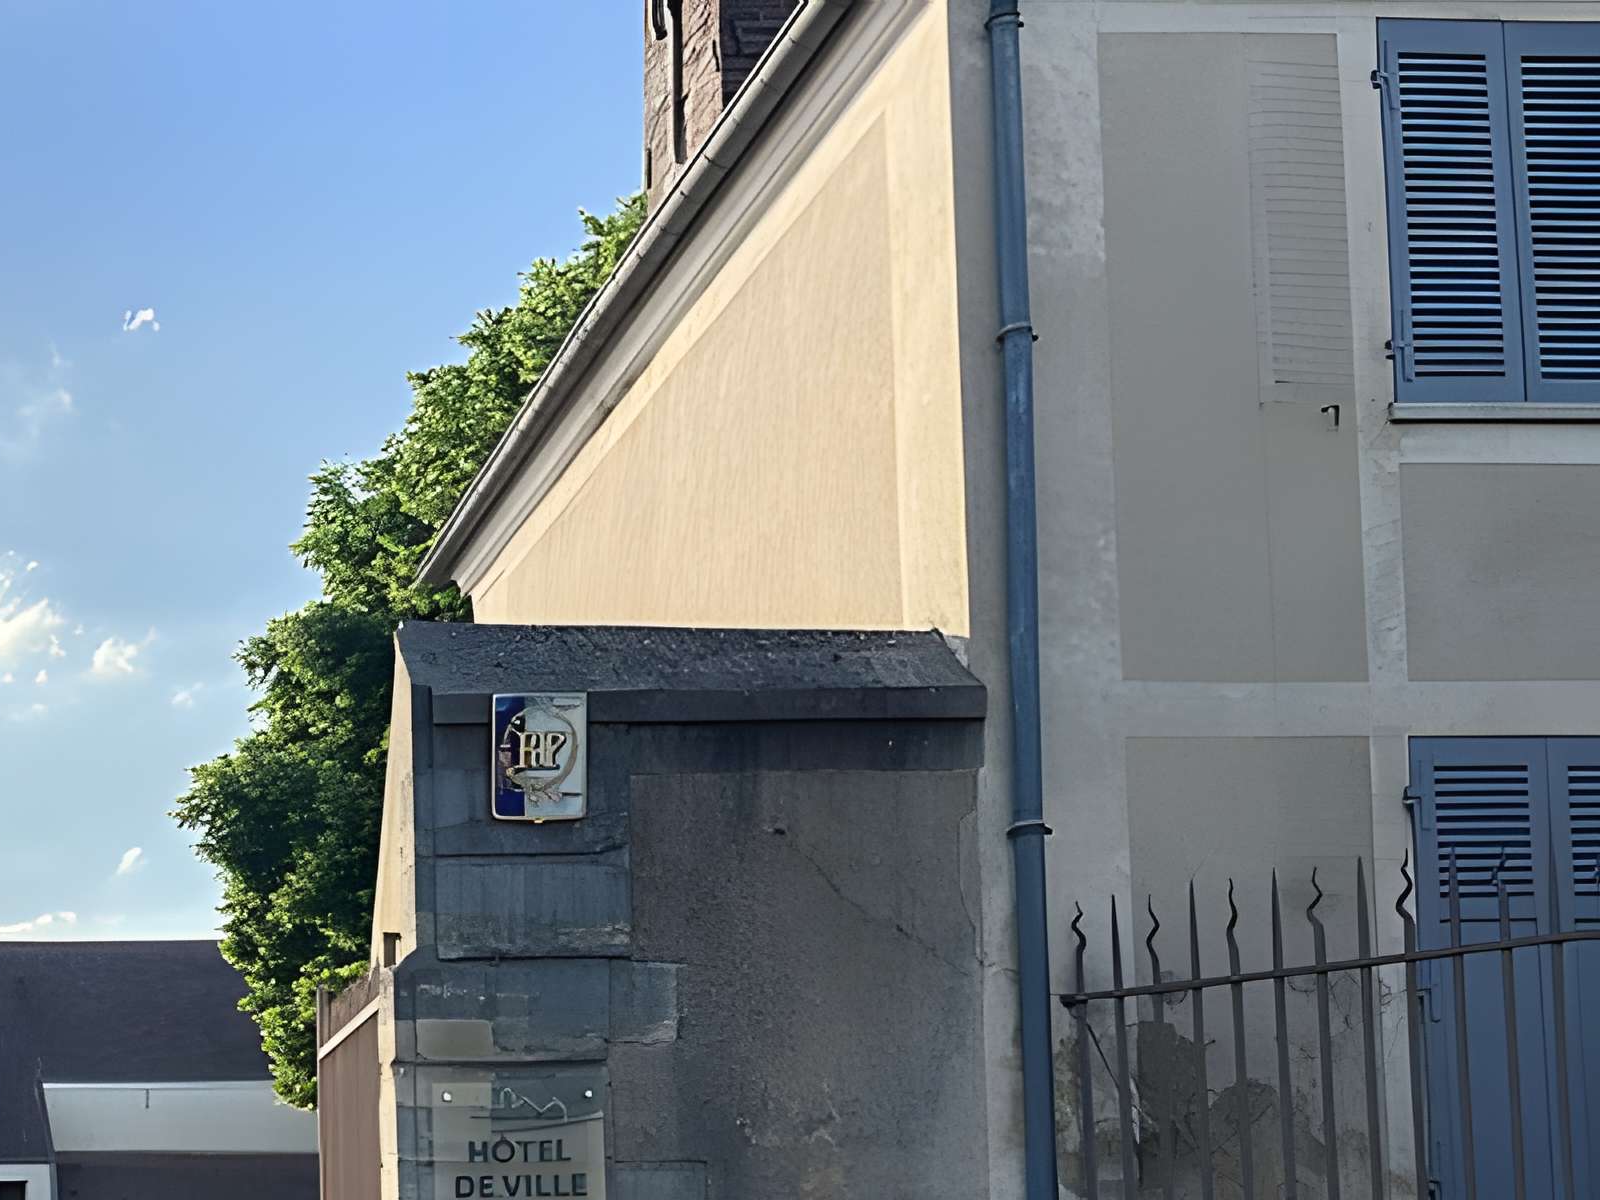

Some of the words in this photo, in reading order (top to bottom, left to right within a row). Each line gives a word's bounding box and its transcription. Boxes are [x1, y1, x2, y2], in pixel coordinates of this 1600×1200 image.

[469, 1134, 572, 1163] HÔTEL
[455, 1175, 494, 1199] DE
[502, 1173, 588, 1198] VILLE
